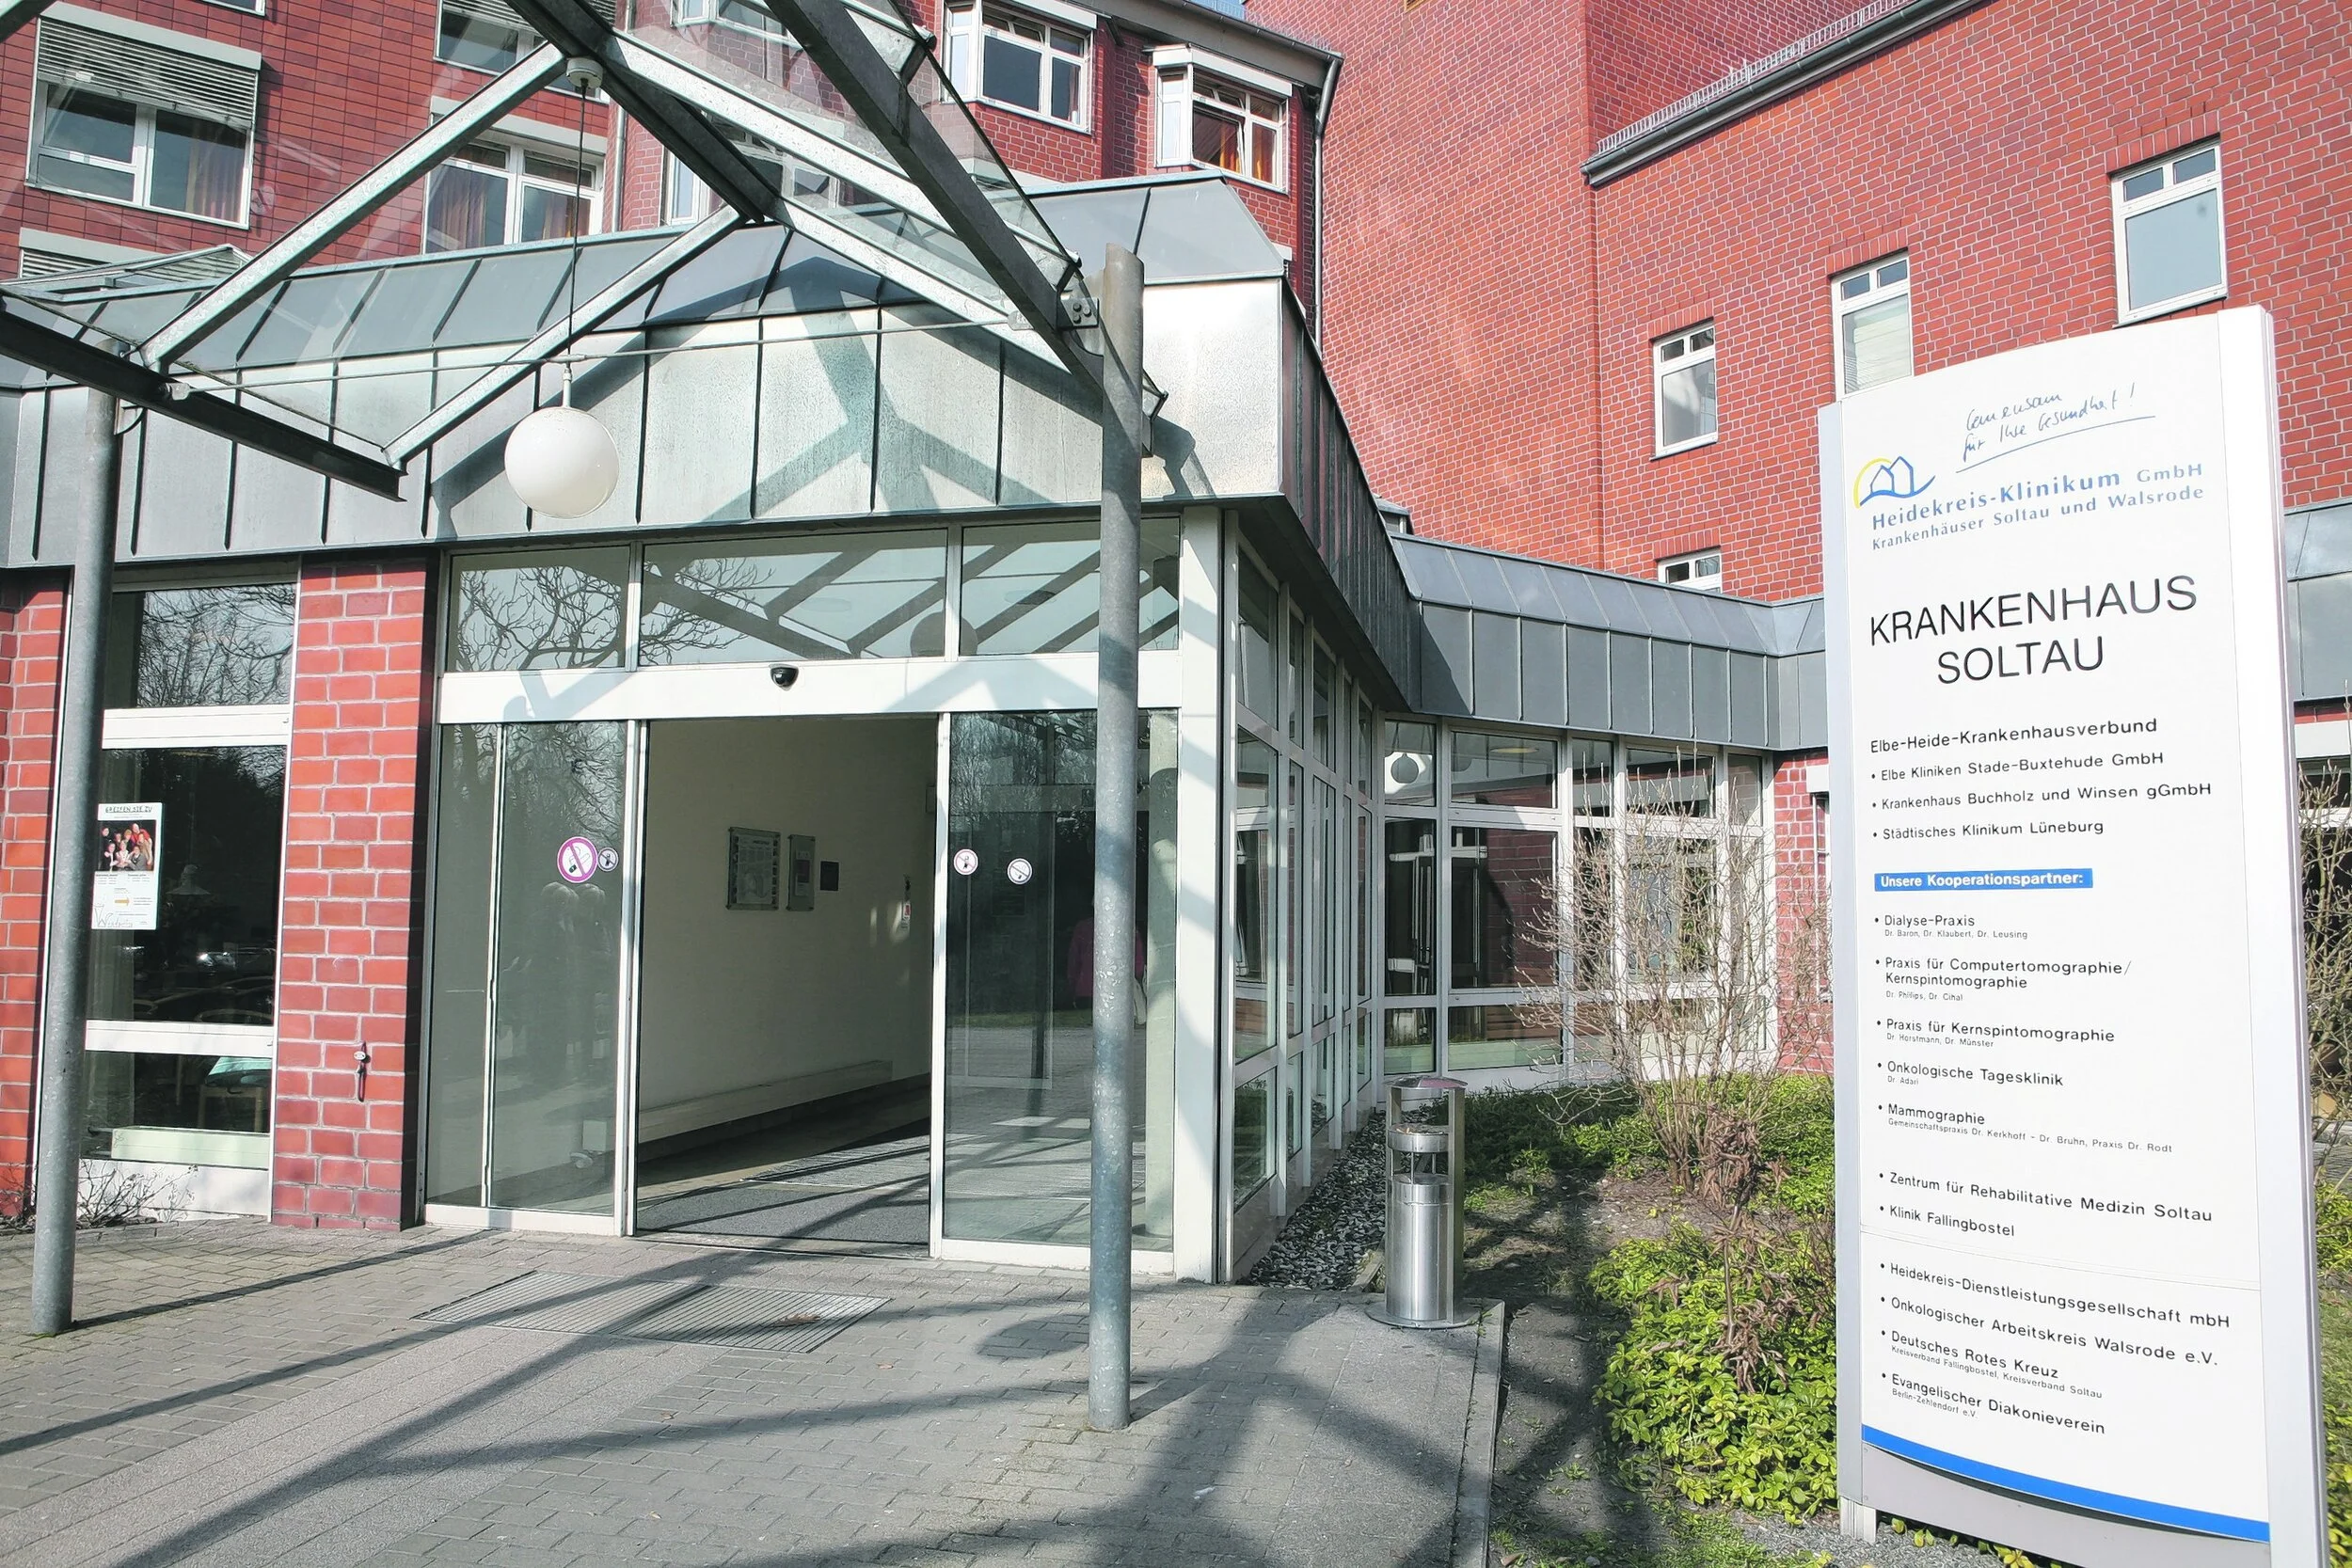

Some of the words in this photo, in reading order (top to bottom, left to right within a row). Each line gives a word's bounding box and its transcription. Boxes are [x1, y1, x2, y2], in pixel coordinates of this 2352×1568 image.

[1963, 433, 1986, 464] für
[1873, 474, 2119, 530] Heidekreis-Klinikum
[2137, 465, 2201, 482] GmbH
[1873, 520, 1982, 549] Krankenhäuser
[1994, 509, 2048, 525] Soltau
[2061, 498, 2095, 515] und
[2108, 486, 2202, 507] Walsrode
[1871, 576, 2196, 646] KRANKENHAUS
[1938, 636, 2103, 684] SOLTAU
[1871, 719, 2156, 752] Elbe-Heide-Krankenhausverbund
[1882, 769, 1905, 781] Elbe
[1912, 766, 1961, 777] Kliniken
[1968, 756, 2103, 774] Stade-Buxtehude
[2112, 752, 2163, 766] GmbH
[1883, 796, 1961, 809] Krankenhaus
[1968, 791, 2033, 804] Buchholz
[2042, 789, 2069, 800] und
[2077, 787, 2137, 799] Winsen
[2147, 784, 2210, 800] gGmbH
[1883, 827, 1955, 839] Städtisches
[1963, 824, 2022, 835] Klinikum
[2030, 821, 2103, 834] Lüneburg
[1882, 877, 1922, 887] Unsere
[1928, 873, 2082, 888] Kooperationspartner:
[1885, 915, 1975, 927] Dialyse-Praxis
[1897, 928, 1921, 938] Baron,
[1993, 930, 2028, 941] Leusing
[1886, 958, 1920, 969] Praxis
[1927, 958, 1943, 969] für
[1950, 958, 2130, 975] Computertomographie/
[1886, 973, 2026, 990] Kernspintomographie
[1887, 1019, 1921, 1031] Praxis
[1929, 1021, 1945, 1032] für
[1952, 1022, 2114, 1042] Kernspintomographie
[1959, 1037, 1994, 1048] Münster
[1888, 1061, 1973, 1079] Onkologische
[1980, 1069, 2063, 1085] Tagesklinik
[1888, 1103, 1984, 1124] Mammographie
[1887, 1117, 1968, 1135] Gemeinschaftspraxis
[1987, 1129, 2026, 1141] Kerkhoff
[2057, 1135, 2088, 1148] Bruhn,
[2091, 1138, 2123, 1149] Praxis
[2147, 1143, 2172, 1153] Rodt
[1890, 1172, 1939, 1190] Zentrum
[1947, 1181, 1963, 1194] für
[1971, 1184, 2072, 1207] Rehabilitative
[2081, 1197, 2144, 1214] Medizin
[2154, 1205, 2211, 1221] Soltau
[1890, 1205, 1920, 1221] Klinik
[1928, 1212, 2013, 1236] Fallingbostel
[1891, 1263, 2180, 1323] Heidekreis-Dienstleistungsgesellschaft
[2190, 1314, 2229, 1327] mbH
[1892, 1297, 1984, 1327] Onkologischer
[1992, 1320, 2086, 1346] Arbeitskreis
[2095, 1337, 2175, 1359] Walsrode
[2185, 1352, 2217, 1365] e.V.
[1892, 1331, 1958, 1357] Deutsches
[1965, 1349, 2006, 1368] Rotes
[2014, 1359, 2058, 1378] Kreuz
[1891, 1344, 1941, 1365] Kreisverband
[1943, 1357, 1999, 1380] Fallingbostel,
[2002, 1371, 2065, 1392] Kreisverband
[2069, 1385, 2103, 1399] Soltau
[1891, 1387, 1960, 1415] Berlin-Zehlendorf
[1962, 1409, 1978, 1418] e.V.
[1893, 1373, 1981, 1407] Evangelischer
[1989, 1400, 2104, 1433] Diakonieverein
